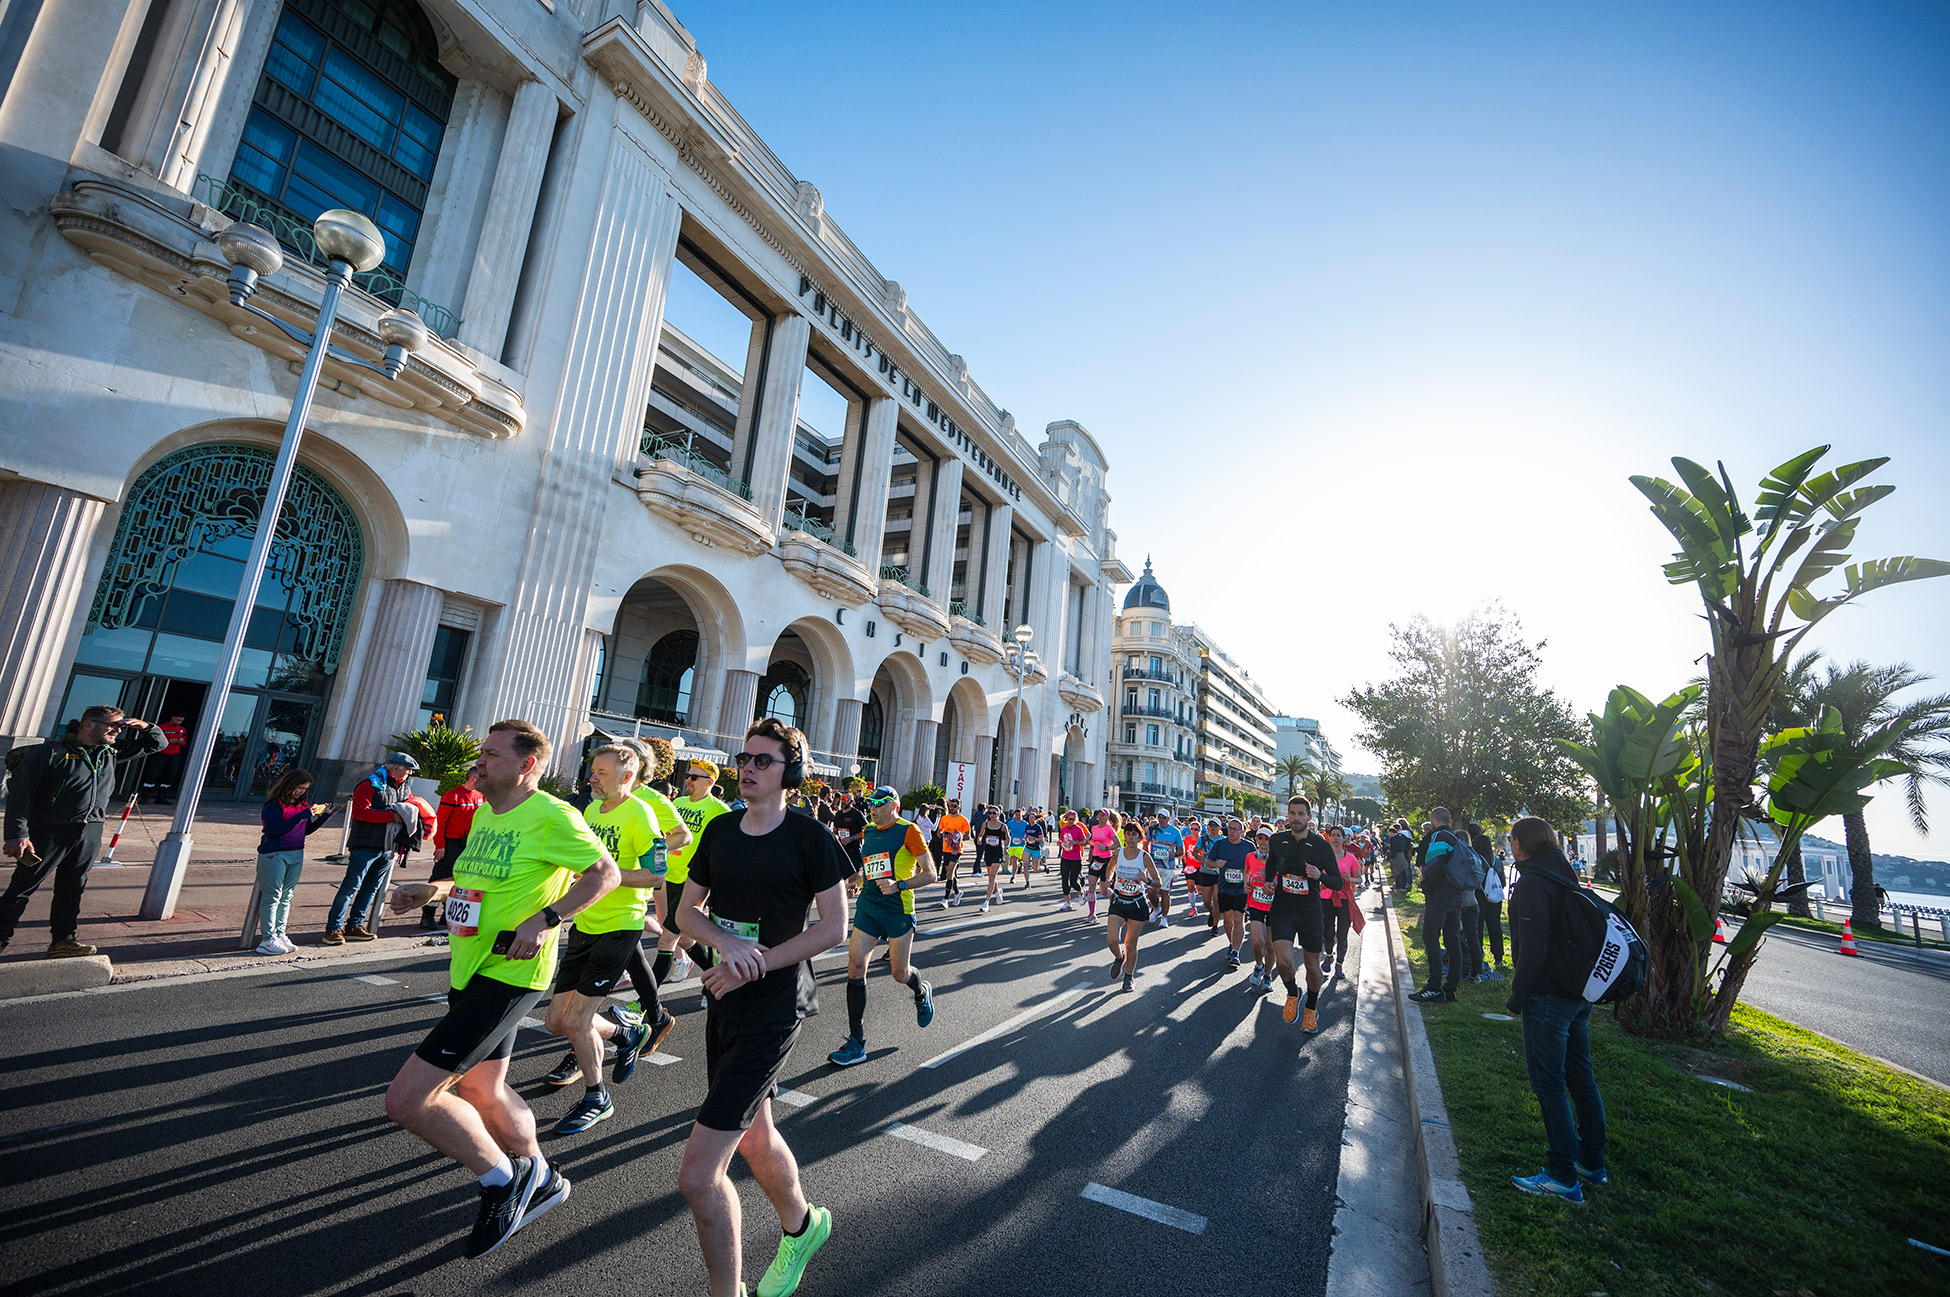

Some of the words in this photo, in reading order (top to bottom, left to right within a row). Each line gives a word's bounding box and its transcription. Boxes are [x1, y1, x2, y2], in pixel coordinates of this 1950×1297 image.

[799, 276, 872, 358] PALAIS
[879, 354, 898, 385] DE
[903, 379, 921, 407] LA
[836, 607, 969, 675] CASINO
[957, 763, 965, 800] CASI
[866, 860, 886, 874] 3775
[1121, 883, 1137, 892] 5027
[1285, 879, 1305, 890] 3424
[447, 900, 471, 923] 4026
[1592, 940, 1622, 984] 226ERS
